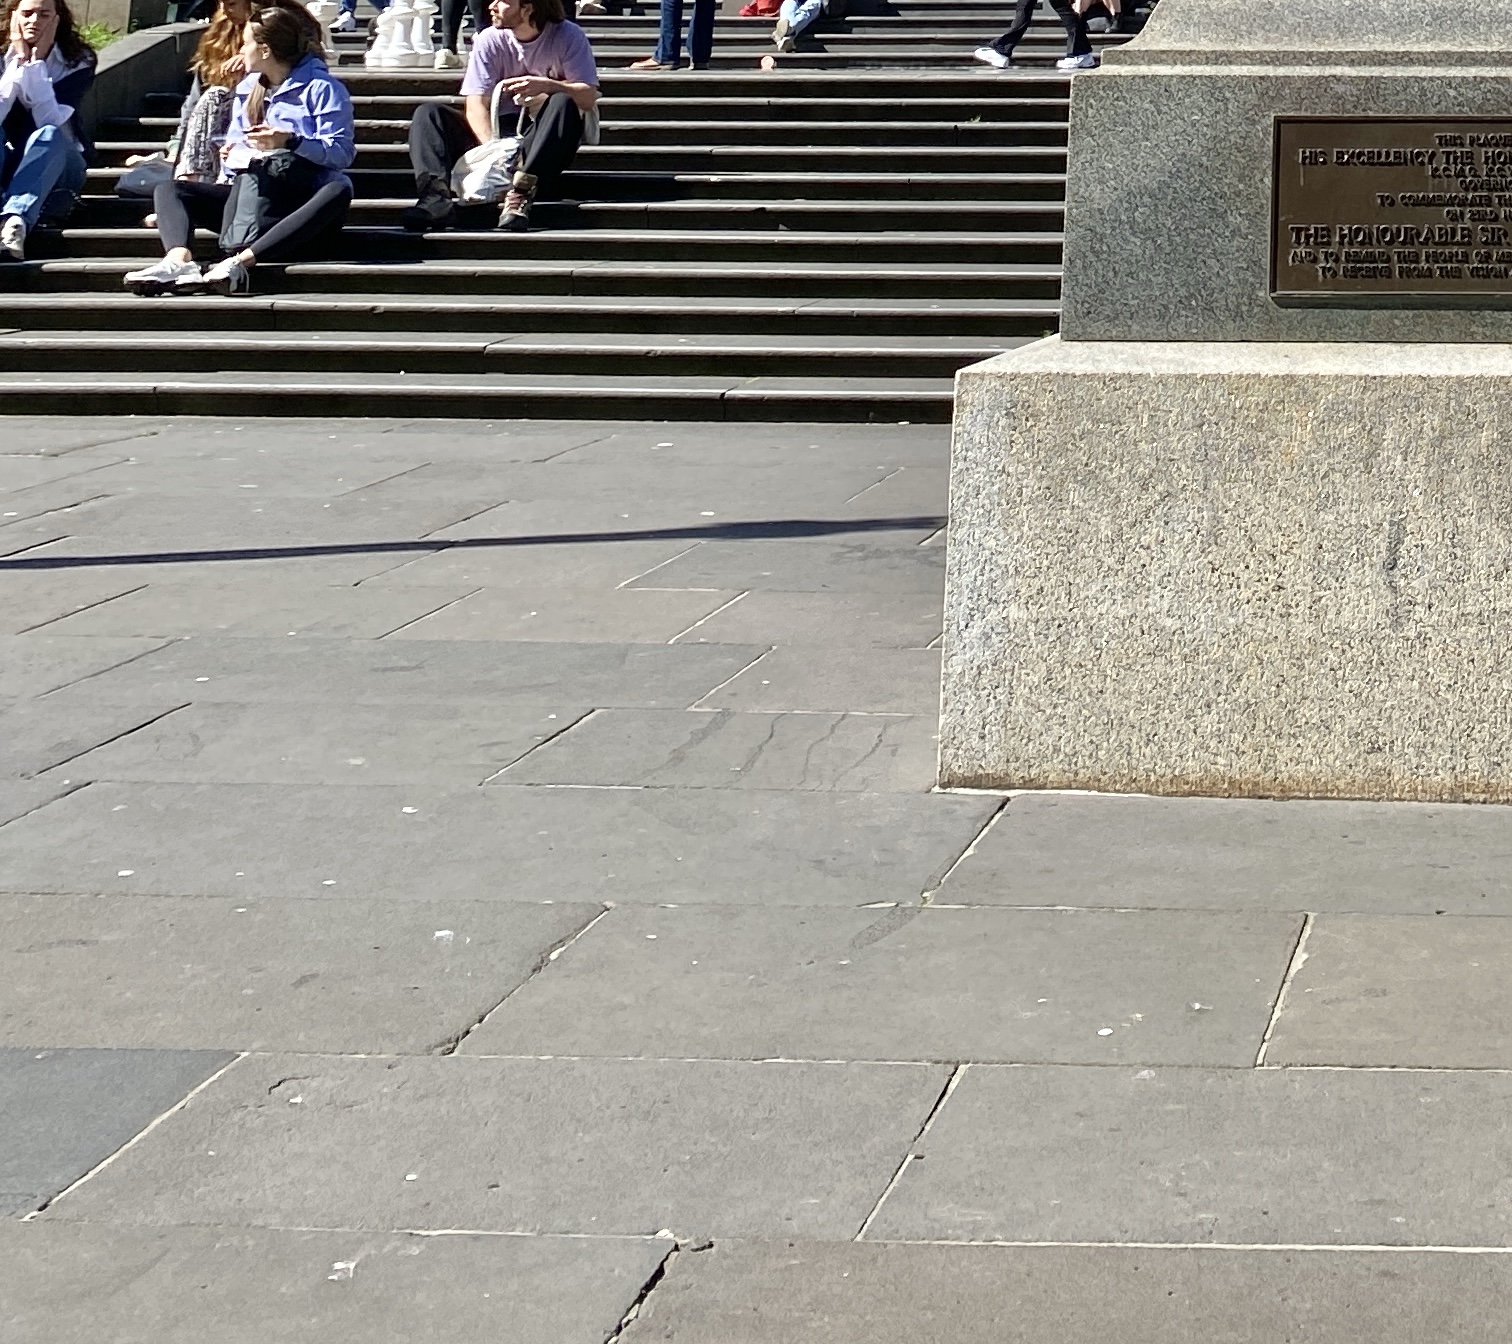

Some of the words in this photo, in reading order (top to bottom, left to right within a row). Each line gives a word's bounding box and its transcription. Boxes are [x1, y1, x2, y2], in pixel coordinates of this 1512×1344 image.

[1434, 133, 1464, 147] THIS
[1299, 148, 1327, 166] HIS
[1333, 148, 1436, 166] EXCELLENCY
[1439, 149, 1474, 166] THE
[1375, 192, 1396, 207] TO
[1398, 192, 1493, 208] COMMEMORATE
[1288, 224, 1332, 246] THE
[1335, 224, 1473, 247] HONOURABLE
[1478, 225, 1511, 247] SIR
[1288, 249, 1317, 265] AND
[1319, 249, 1340, 262] TO
[1342, 249, 1390, 262] REMIND
[1393, 249, 1419, 263] THE
[1421, 249, 1469, 263] PEOPLE
[1473, 250, 1491, 263] OF
[1317, 263, 1338, 279] TO
[1340, 264, 1394, 279] RECEIVE
[1396, 264, 1433, 279] FROM
[1435, 264, 1462, 279] THE
[1467, 264, 1509, 279] VISION
